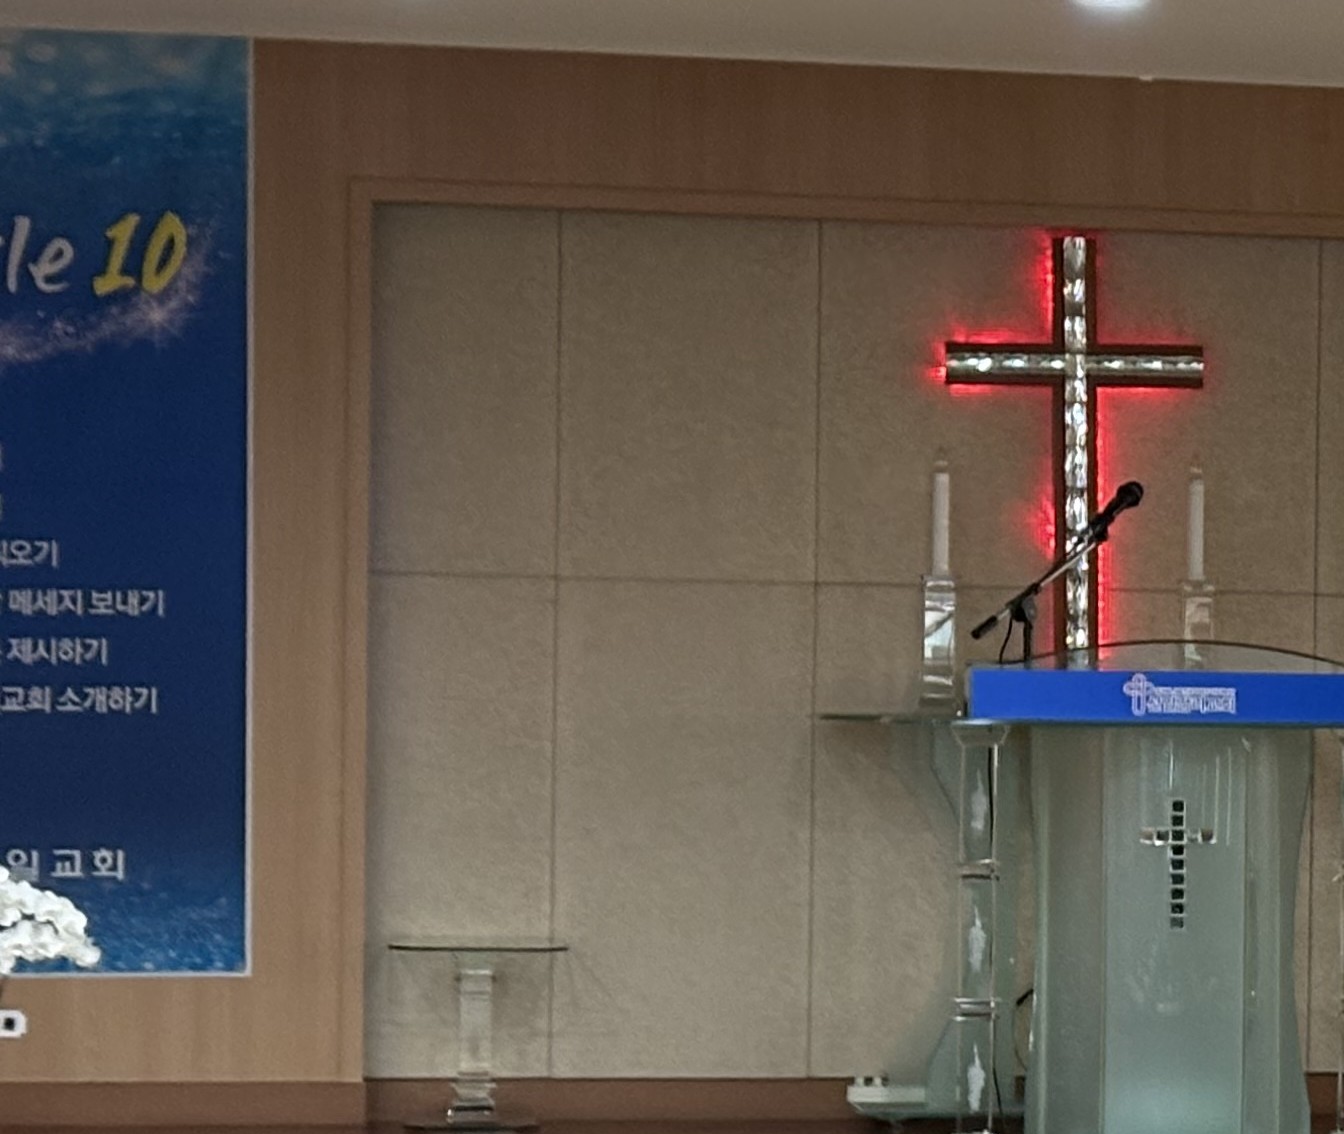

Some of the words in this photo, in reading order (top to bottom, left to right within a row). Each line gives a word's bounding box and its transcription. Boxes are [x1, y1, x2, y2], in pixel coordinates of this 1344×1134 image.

[0, 215, 74, 293] le
[93, 210, 187, 296] 10
[8, 589, 83, 616] 메세지
[88, 589, 165, 618] 보내기
[6, 637, 108, 666] 제시하기
[0, 685, 51, 714] 교회
[56, 685, 158, 715] 소개하기
